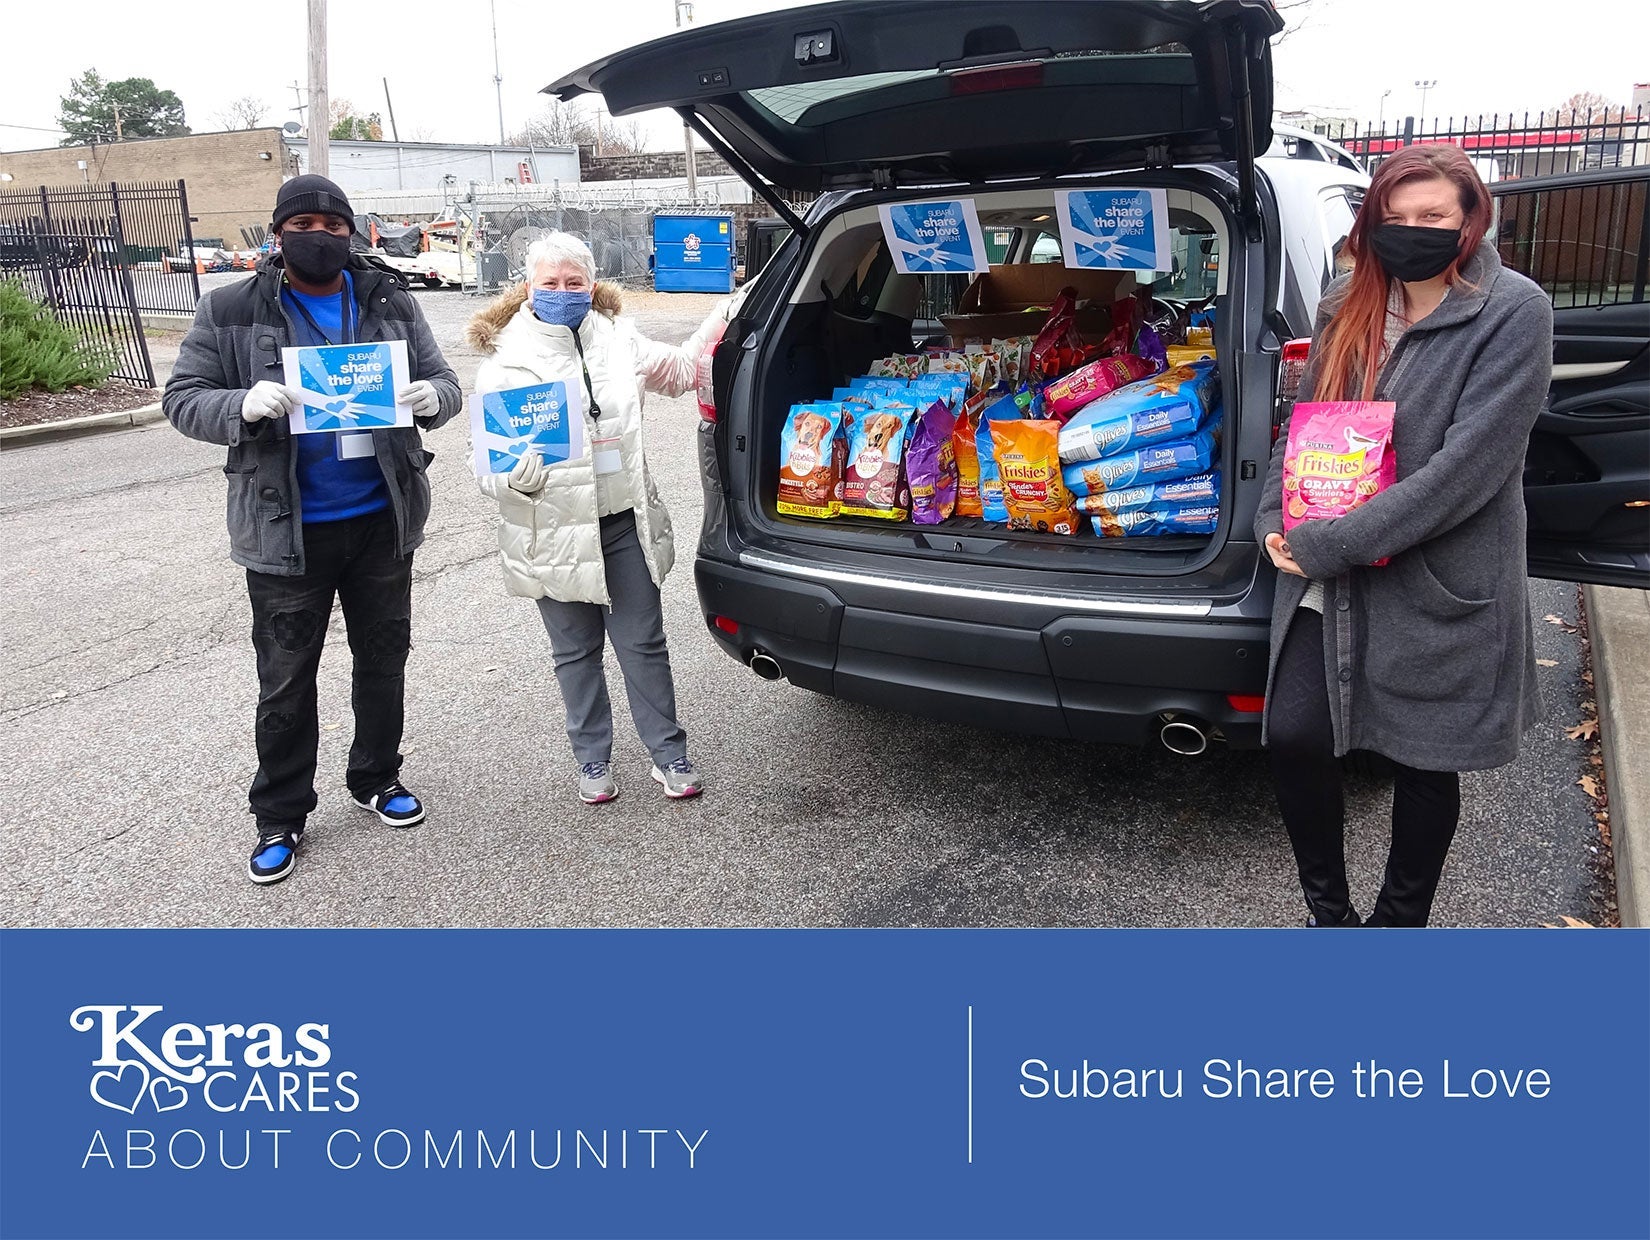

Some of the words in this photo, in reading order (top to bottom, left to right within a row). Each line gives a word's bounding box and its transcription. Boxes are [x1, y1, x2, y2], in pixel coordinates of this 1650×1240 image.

[1111, 198, 1142, 206] SUBARU
[927, 209, 954, 217] SUBARU
[1105, 206, 1143, 216] share
[923, 218, 956, 228] share
[1093, 217, 1115, 228] the
[1118, 216, 1144, 228] love
[915, 228, 934, 238] the
[935, 227, 959, 236] love
[940, 235, 960, 243] EVENT
[347, 352, 381, 361] SUBARU
[340, 361, 381, 374] share
[327, 374, 352, 387] the
[353, 372, 384, 385] love
[357, 383, 384, 392] EVENT
[526, 390, 557, 401] SUBARU
[520, 400, 559, 415] share
[508, 415, 532, 428] the
[533, 411, 560, 424] love
[1149, 409, 1169, 422] Daily
[537, 421, 560, 432] EVENT
[1137, 418, 1171, 431] Essentials
[788, 451, 816, 464] Kibbles
[858, 453, 884, 464] Kibbles
[1155, 448, 1175, 459] Daily
[1143, 457, 1176, 469] Essentials
[1302, 455, 1359, 474] Friskies
[1004, 465, 1046, 479] Friskies
[846, 481, 865, 489] BISTRO
[1009, 482, 1034, 490] Tender
[1165, 479, 1212, 494] Essentials
[1303, 480, 1352, 489] GRAVY
[1015, 489, 1045, 497] CRUNCHY
[1309, 489, 1345, 497] Swirlers
[791, 504, 808, 513] MORE
[808, 506, 824, 515] FREE
